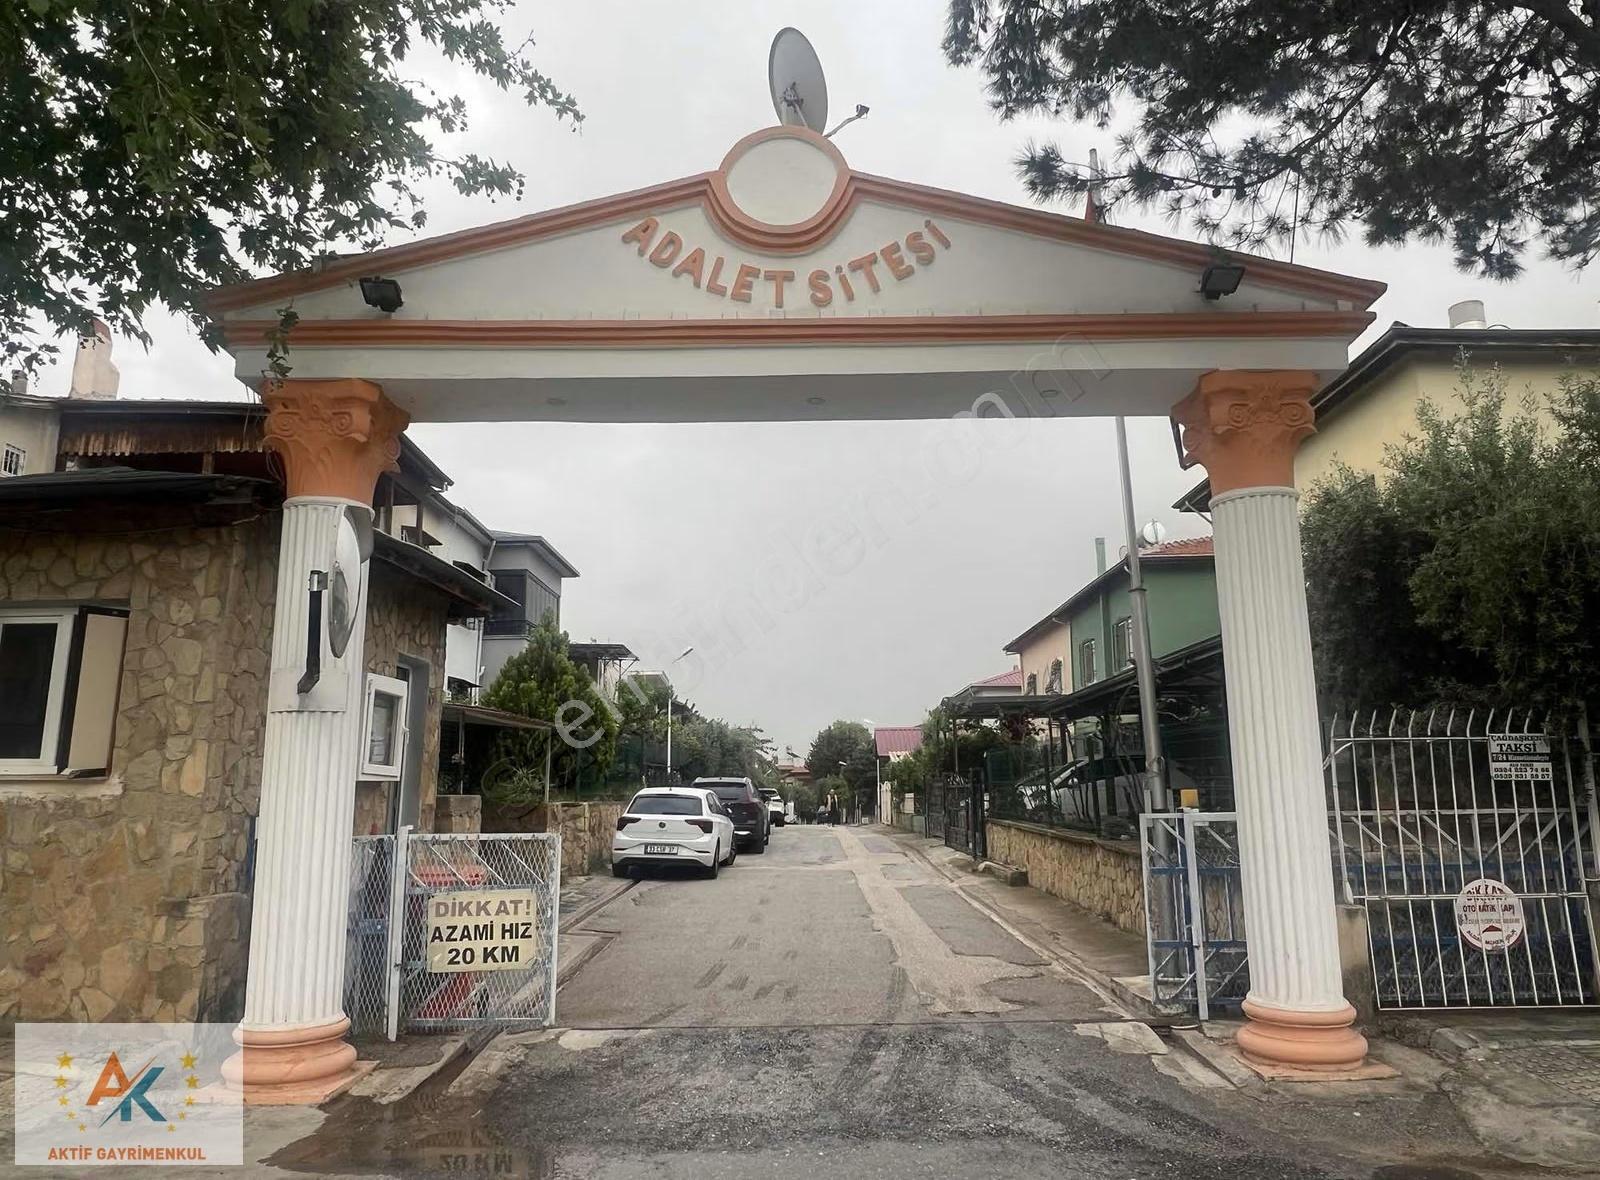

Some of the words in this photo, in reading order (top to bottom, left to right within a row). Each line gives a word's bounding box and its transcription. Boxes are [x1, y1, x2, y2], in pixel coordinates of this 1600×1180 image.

[621, 217, 795, 309] ADALET
[808, 219, 951, 308] SİTESİ
[1497, 741, 1537, 752] TAKSİ
[434, 897, 531, 917] DİKKAT!
[430, 920, 494, 943] AZAMİ
[501, 922, 533, 940] HIZ
[447, 948, 475, 965] 20
[482, 946, 520, 963] KM
